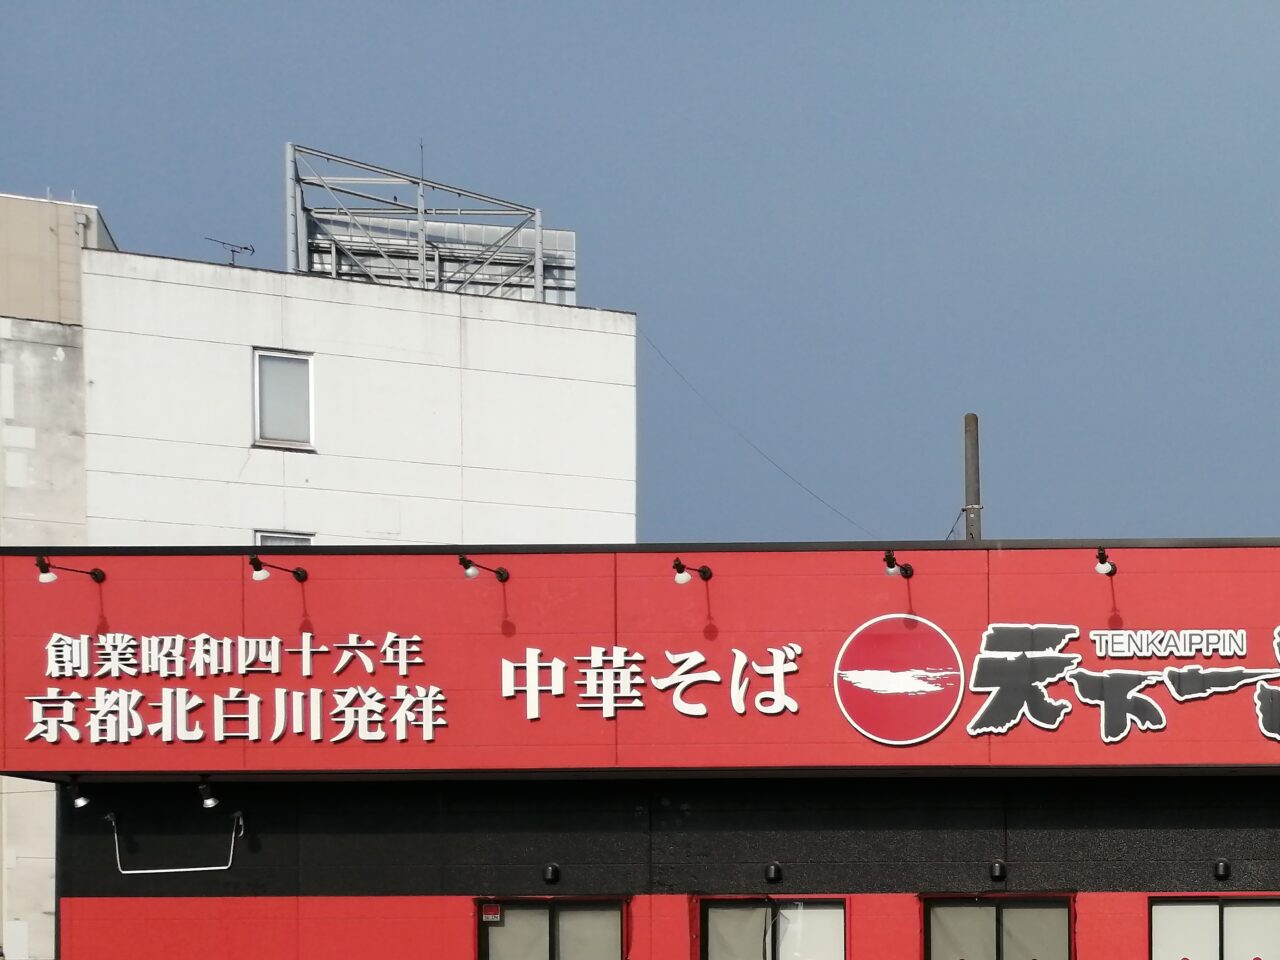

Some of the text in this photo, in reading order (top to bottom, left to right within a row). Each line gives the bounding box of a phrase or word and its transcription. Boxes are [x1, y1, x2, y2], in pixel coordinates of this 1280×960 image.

[45, 632, 424, 679] 創業昭和四十六年
[1090, 629, 1246, 657] TENKAIPPIN
[501, 642, 802, 721] 中華そば
[24, 686, 447, 744] 京都北白川発祥
